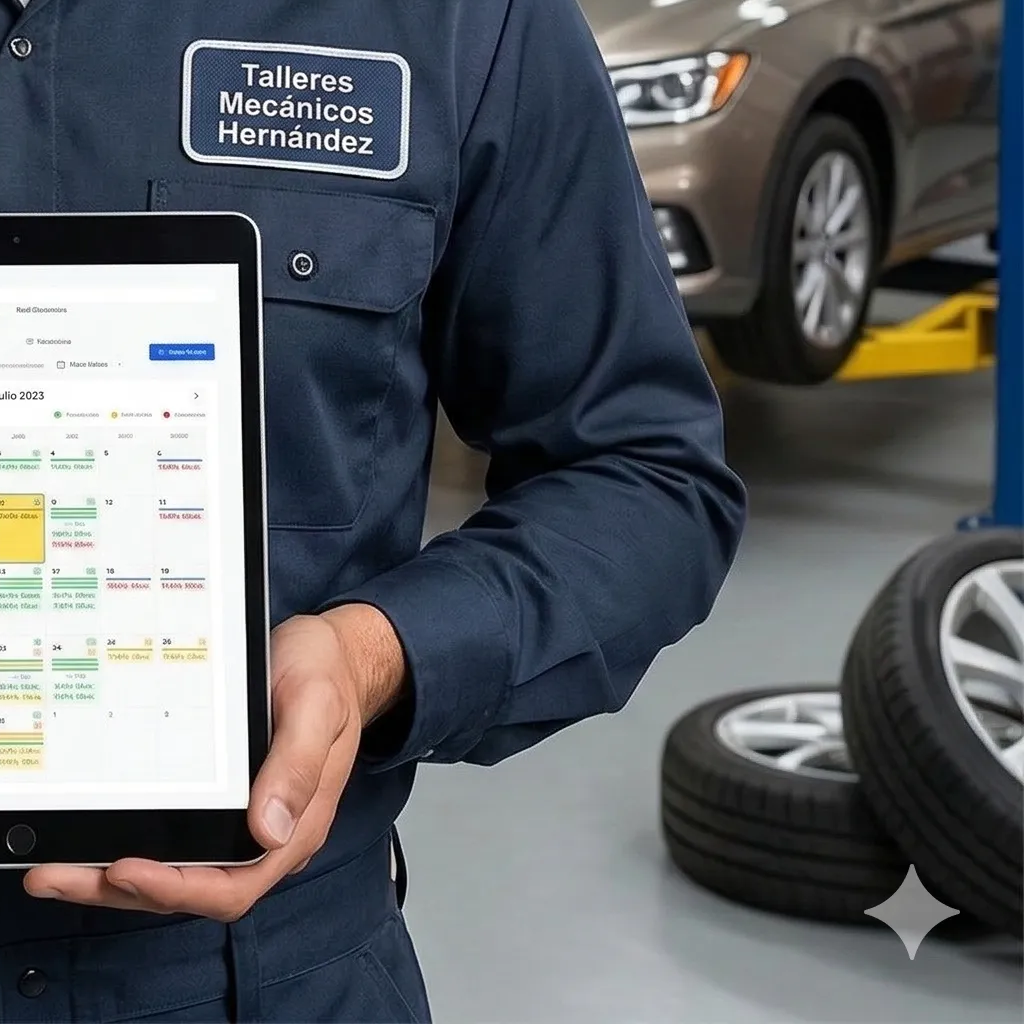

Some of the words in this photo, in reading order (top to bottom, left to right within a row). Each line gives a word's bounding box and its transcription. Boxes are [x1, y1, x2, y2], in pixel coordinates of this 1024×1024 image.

[241, 63, 354, 93] Talleres
[219, 91, 374, 125] Mecánicos
[218, 121, 374, 155] Hernández
[19, 390, 45, 401] 2023
